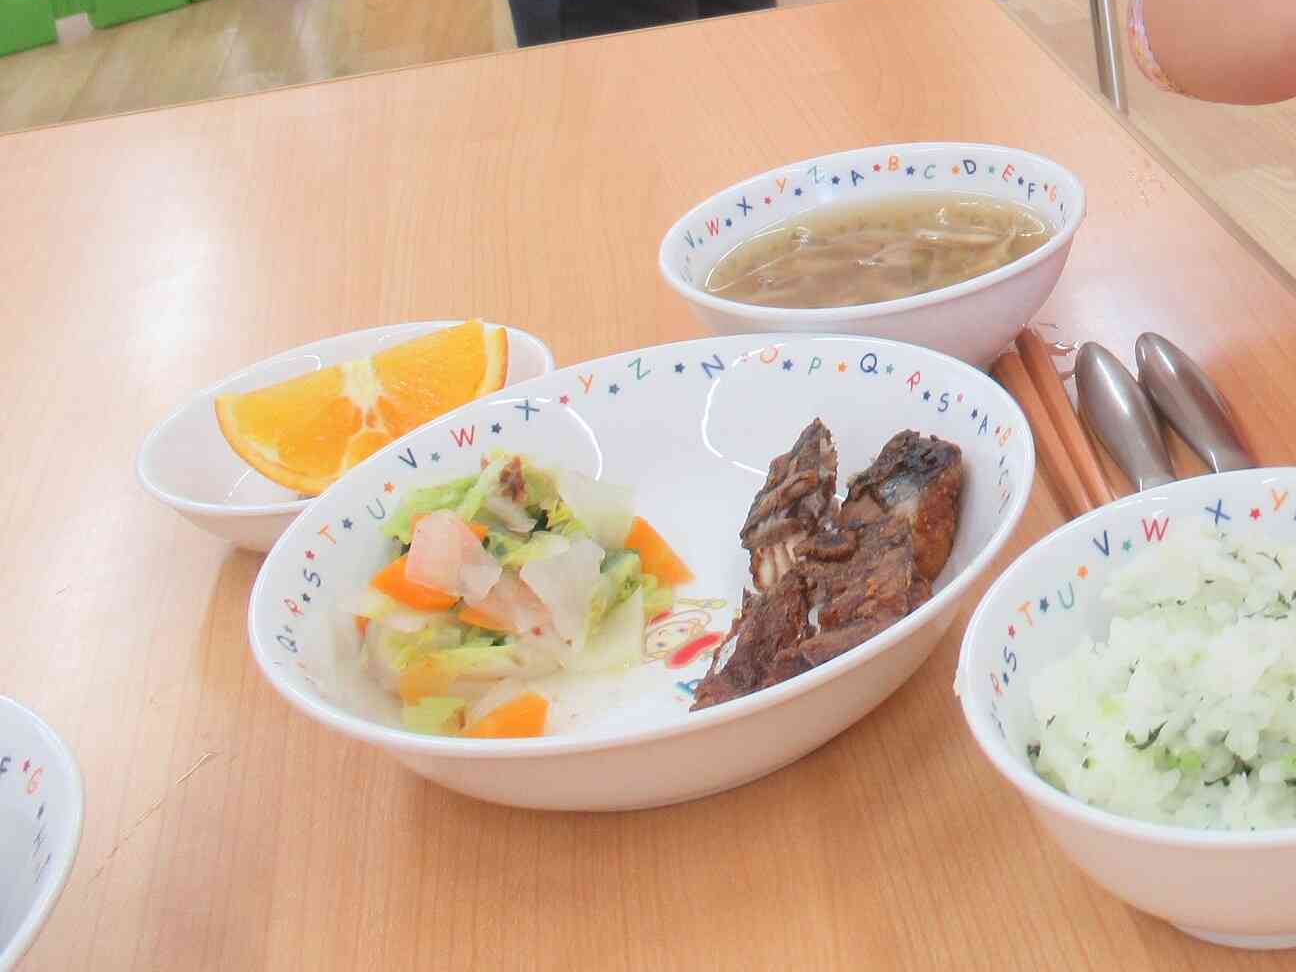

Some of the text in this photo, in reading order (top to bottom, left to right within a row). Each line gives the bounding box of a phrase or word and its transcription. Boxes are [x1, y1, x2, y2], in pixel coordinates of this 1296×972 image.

[705, 217, 720, 237] W
[736, 195, 753, 217] X
[775, 177, 787, 194] Y
[850, 169, 865, 187] A
[887, 155, 900, 172] B
[923, 164, 937, 179] C
[962, 159, 977, 175] D
[1001, 163, 1016, 181] E
[1027, 182, 1037, 201] F
[303, 568, 322, 588] S
[319, 525, 337, 545] T
[366, 497, 387, 520] U
[397, 448, 418, 469] V
[450, 425, 476, 448] W
[514, 399, 541, 421] X
[577, 374, 594, 395] Y
[627, 357, 651, 380] Z
[701, 354, 726, 379] N
[807, 356, 822, 376] P
[860, 353, 879, 374] Q
[906, 371, 921, 391] R
[937, 392, 951, 413] S
[977, 413, 988, 436] A
[1003, 646, 1017, 672] S
[1016, 601, 1034, 626] T
[1057, 581, 1075, 609] U
[1092, 530, 1110, 557] V
[1141, 517, 1169, 543] W
[1205, 499, 1231, 525] X
[1271, 488, 1289, 511] Y
